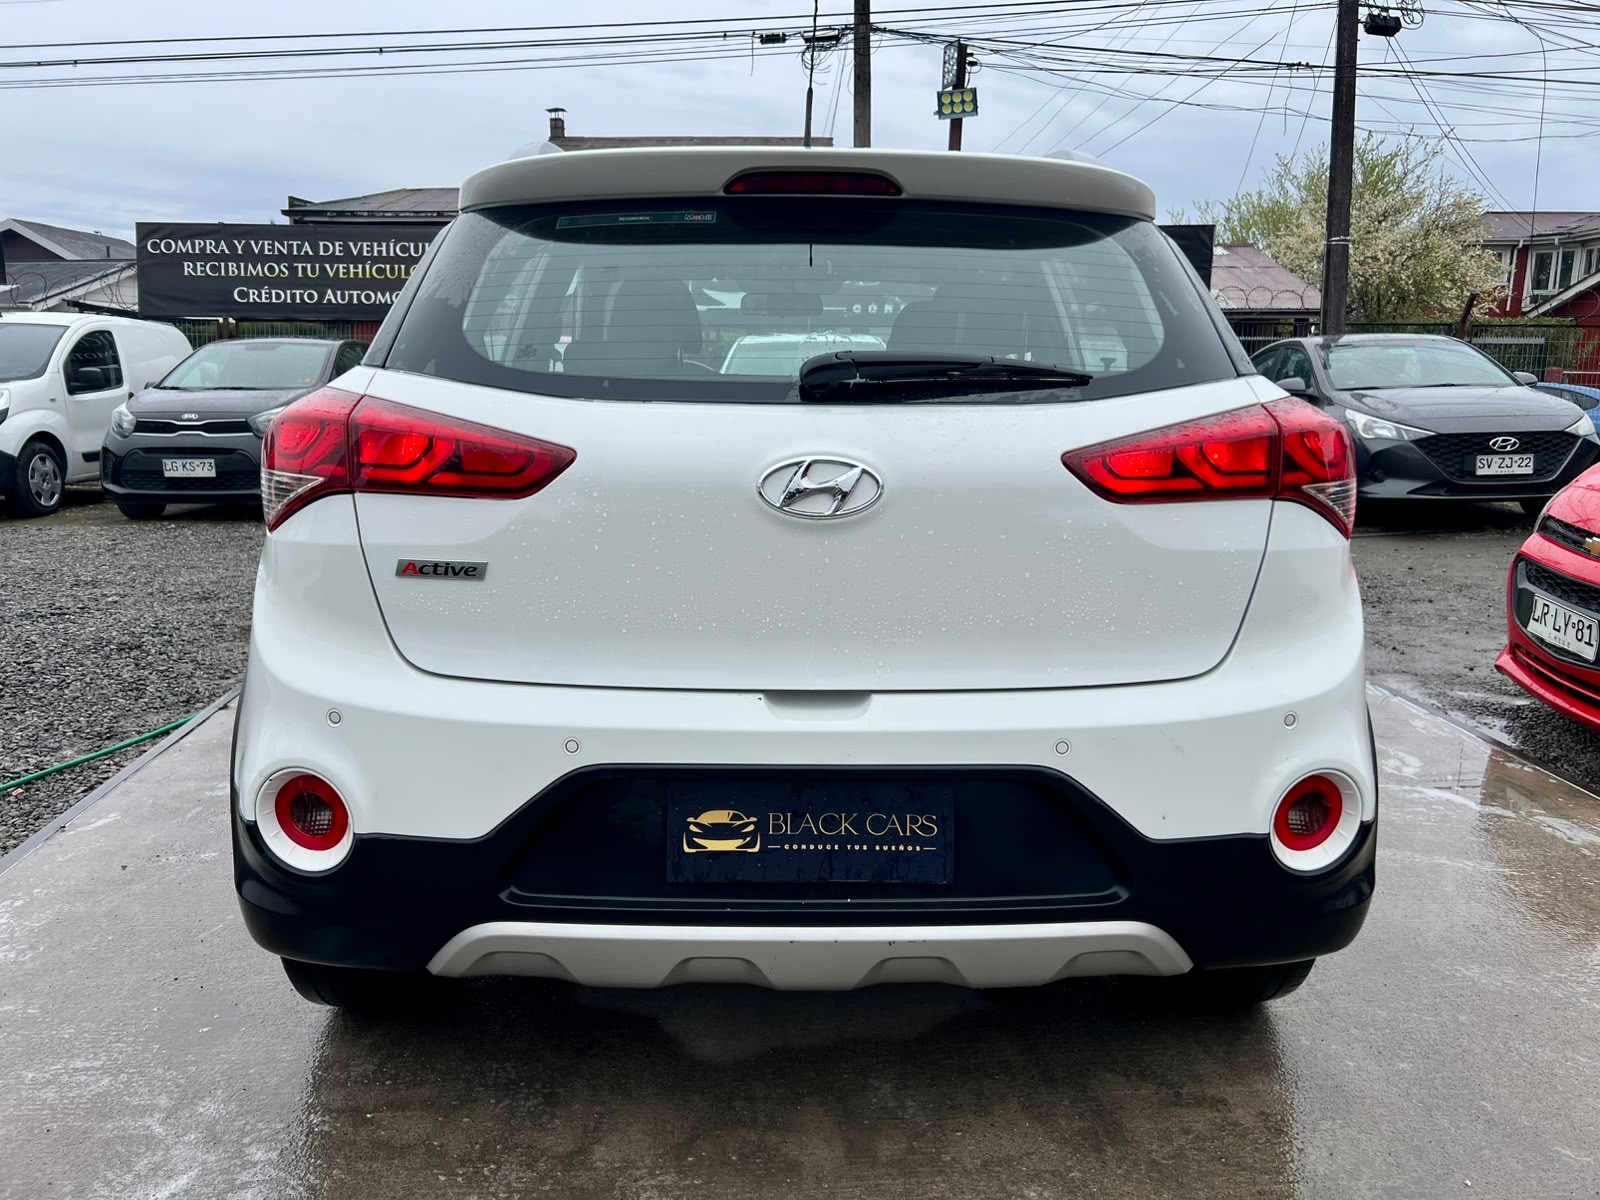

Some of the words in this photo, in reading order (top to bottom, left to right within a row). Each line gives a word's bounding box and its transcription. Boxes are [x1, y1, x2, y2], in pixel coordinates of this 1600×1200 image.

[147, 238, 231, 254] COMPRA
[233, 240, 246, 254] Y
[249, 240, 314, 255] VENTA
[318, 241, 344, 256] DE
[182, 261, 290, 278] RECIBIMOS
[294, 263, 320, 278] TU
[233, 285, 319, 304] CRÉDITO
[401, 561, 478, 577] Active
[767, 812, 860, 836] BLACK
[865, 814, 939, 838] CARS
[783, 843, 840, 851] CONDUCE
[846, 843, 869, 852] TUS
[874, 843, 921, 853] SUEÑOS
